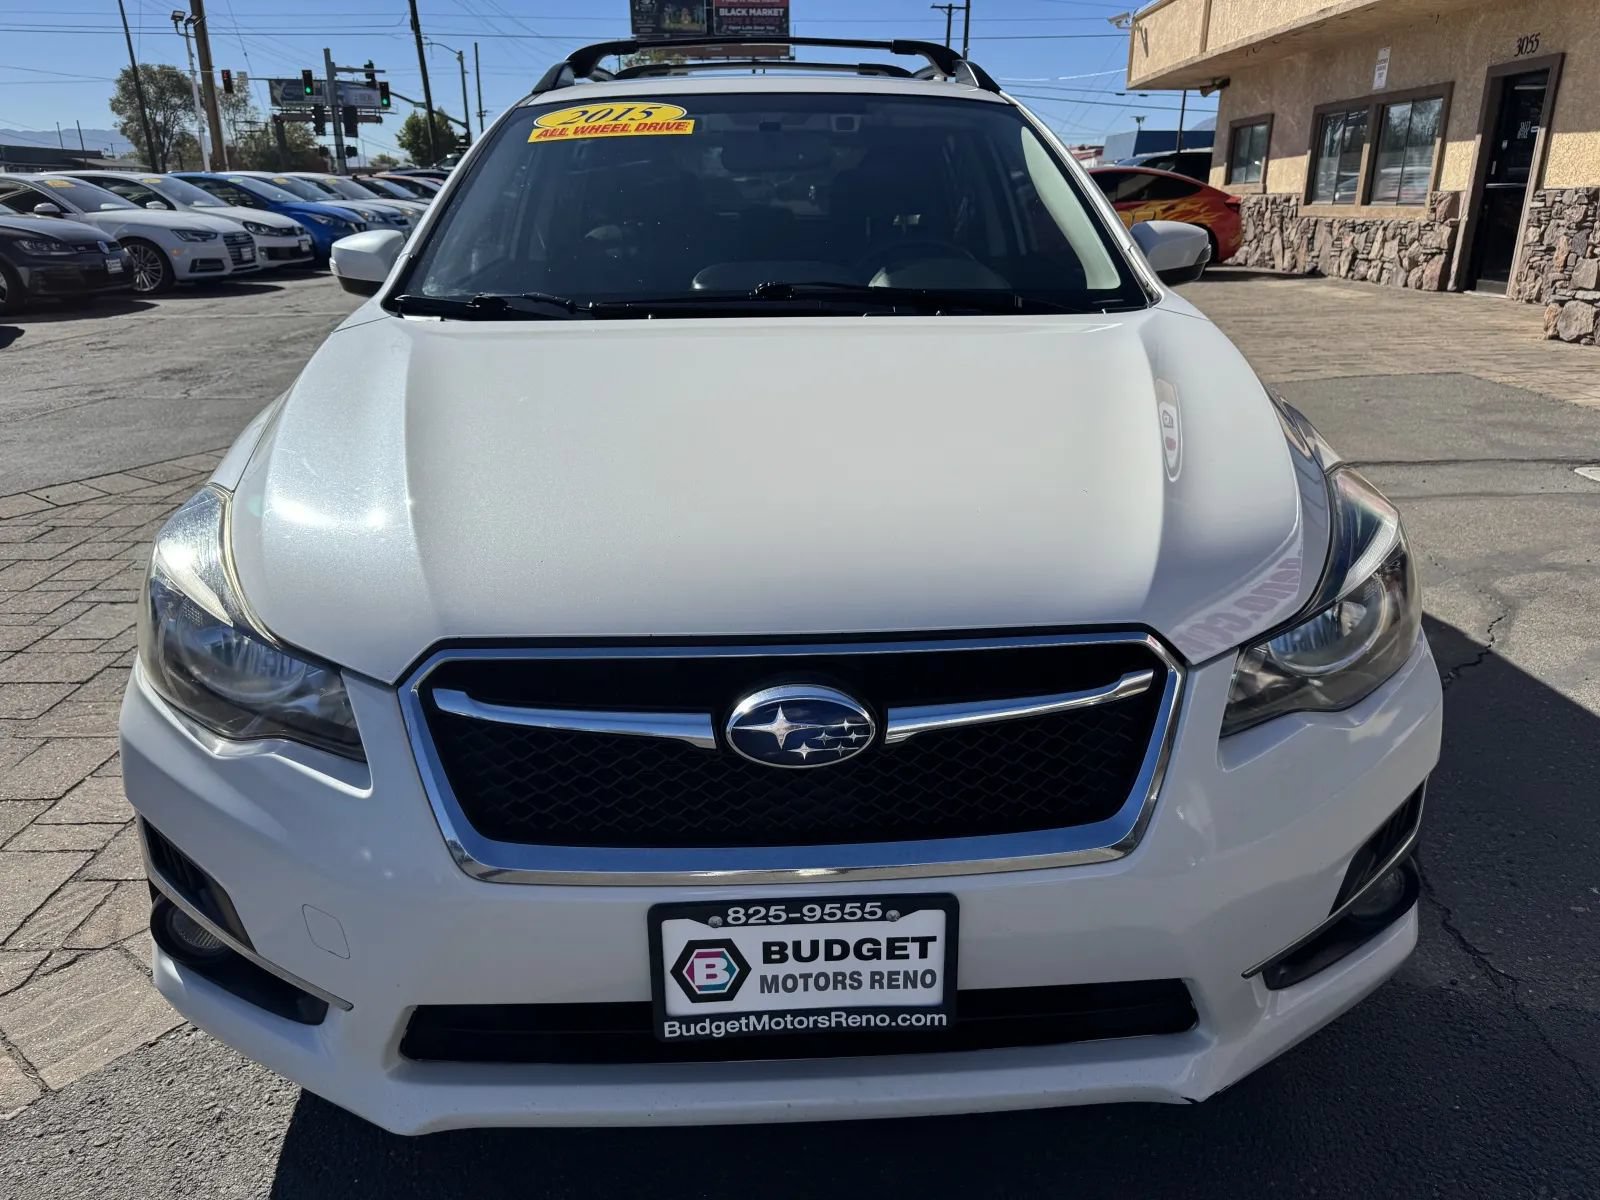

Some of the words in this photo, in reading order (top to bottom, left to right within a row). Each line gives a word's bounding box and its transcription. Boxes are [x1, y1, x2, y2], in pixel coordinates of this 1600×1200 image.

[719, 8, 748, 17] BLACK
[749, 8, 784, 17] MARKET
[1515, 32, 1541, 57] 3055
[559, 107, 661, 125] 2015
[727, 902, 883, 925] 825-9555
[762, 936, 938, 964] BUDGET
[694, 957, 730, 986] B
[759, 971, 863, 994] MOTORS
[869, 969, 937, 990] RENO
[663, 1011, 948, 1038] BudgetMotorsReno.com
